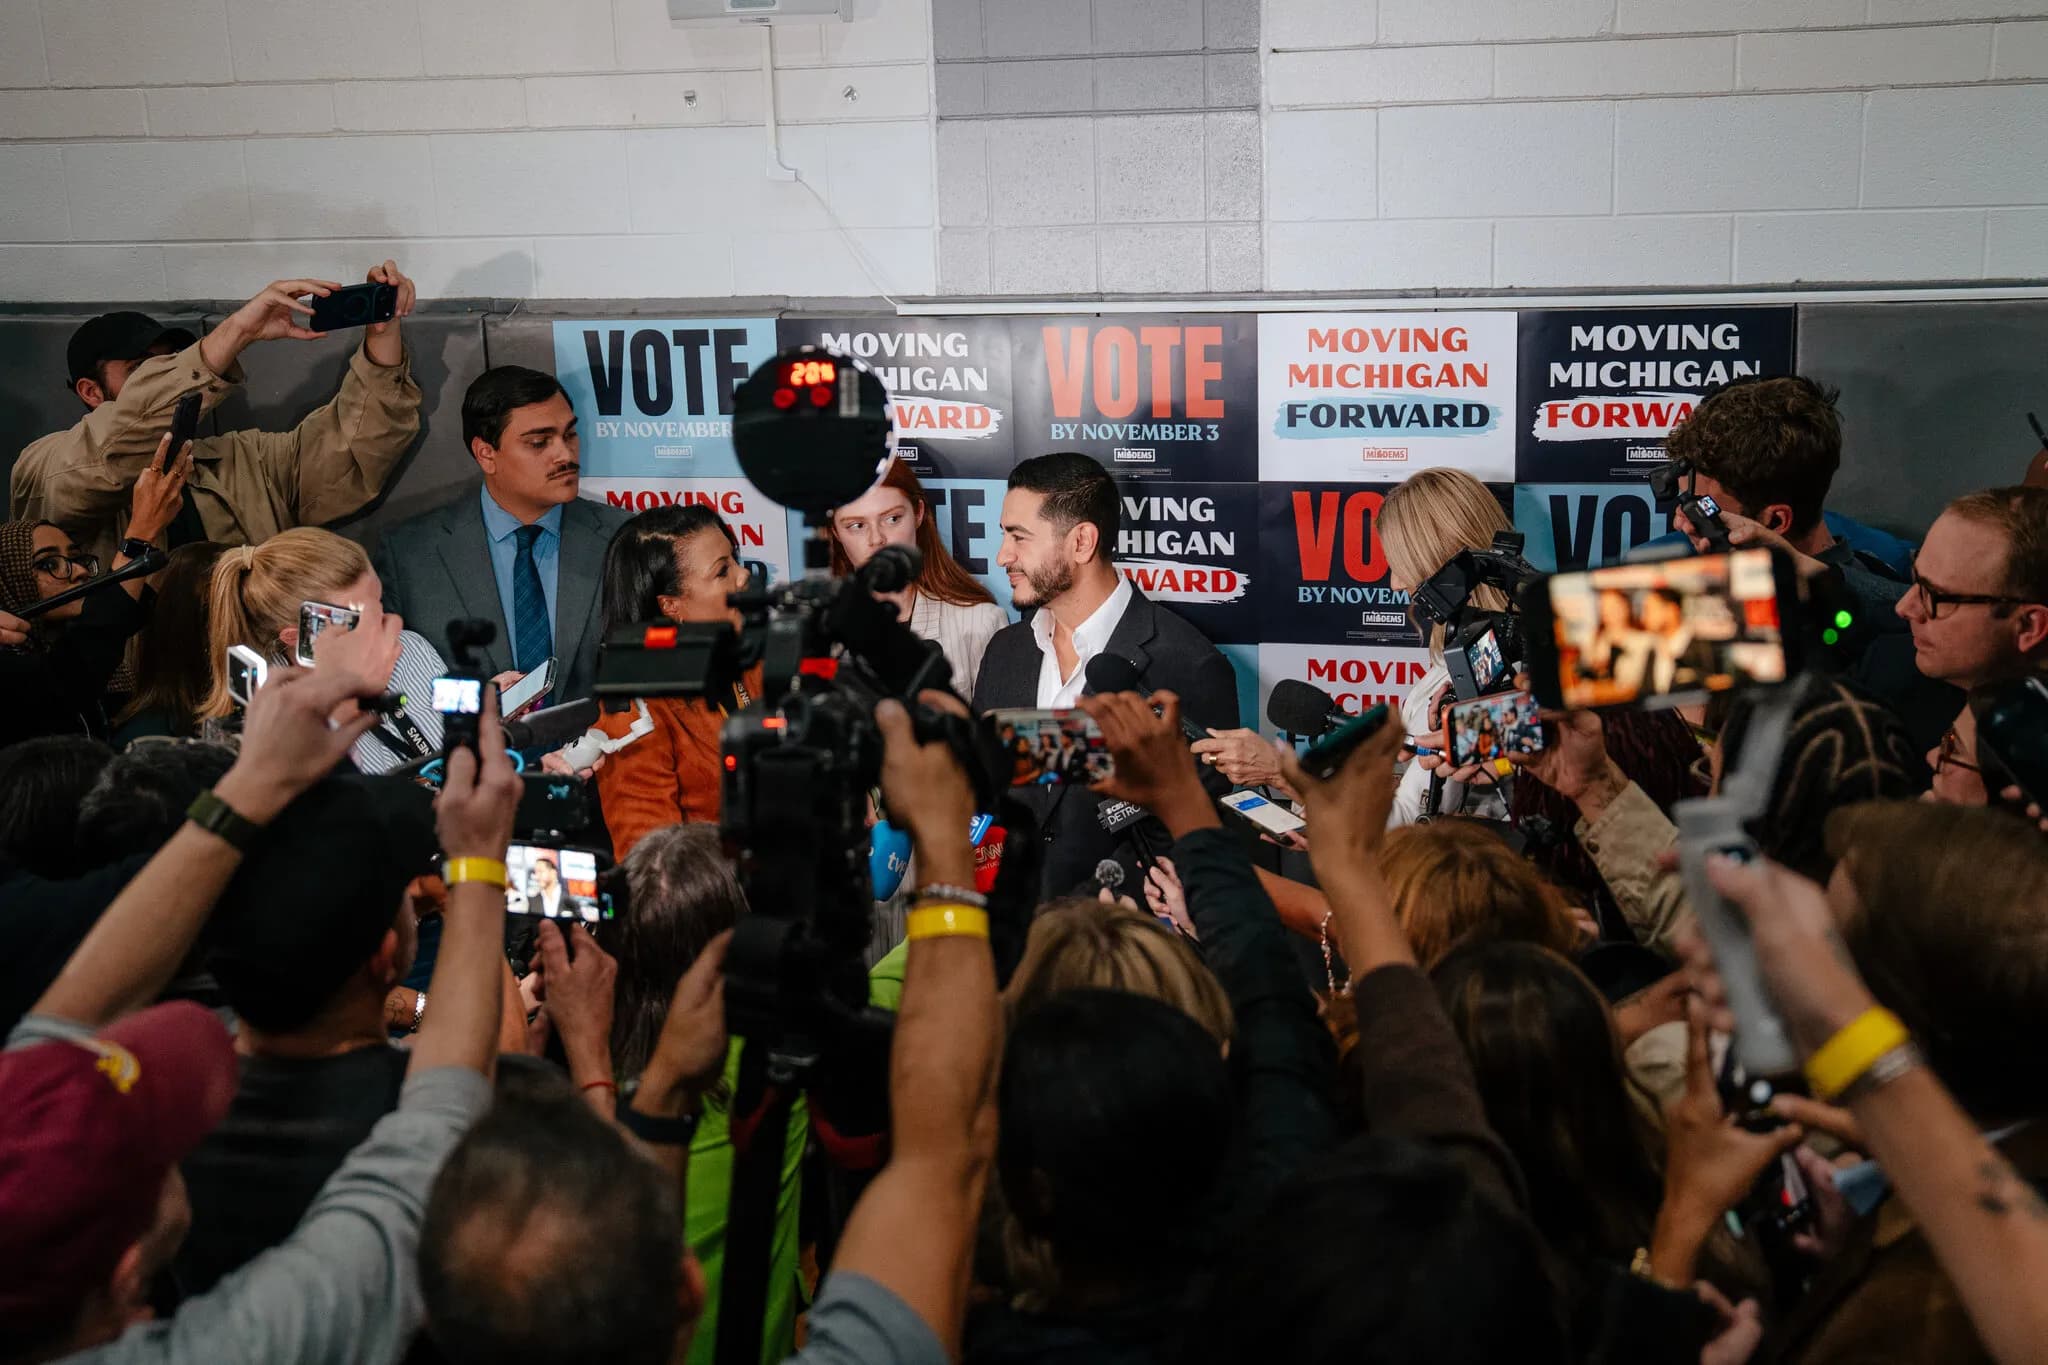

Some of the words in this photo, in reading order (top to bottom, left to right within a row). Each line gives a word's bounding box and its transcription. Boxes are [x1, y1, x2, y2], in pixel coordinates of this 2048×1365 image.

[821, 332, 969, 357] MOVING
[1307, 327, 1469, 353] MOVING
[1571, 323, 1741, 351] MOVING
[583, 329, 750, 416] VOTE
[875, 366, 988, 391] HIGAN
[1042, 326, 1225, 419] VOTE
[1288, 363, 1488, 388] MICHIGAN
[1550, 360, 1761, 388] MICHIGAN
[1287, 403, 1490, 429] FORWARD
[1547, 402, 1694, 428] FORWA
[595, 421, 623, 438] BY
[624, 421, 733, 438] NOVEMBER
[1051, 423, 1079, 440] BY
[1082, 423, 1203, 441] NOVEMBER
[1206, 424, 1220, 441] 3
[1119, 496, 1216, 522] VING
[1113, 530, 1235, 555] HIGAN
[1292, 491, 1390, 583] VO
[1123, 568, 1237, 592] WARD
[1298, 586, 1328, 603] BY
[1330, 587, 1412, 605] NOVEM
[1307, 658, 1433, 685] MOVIN
